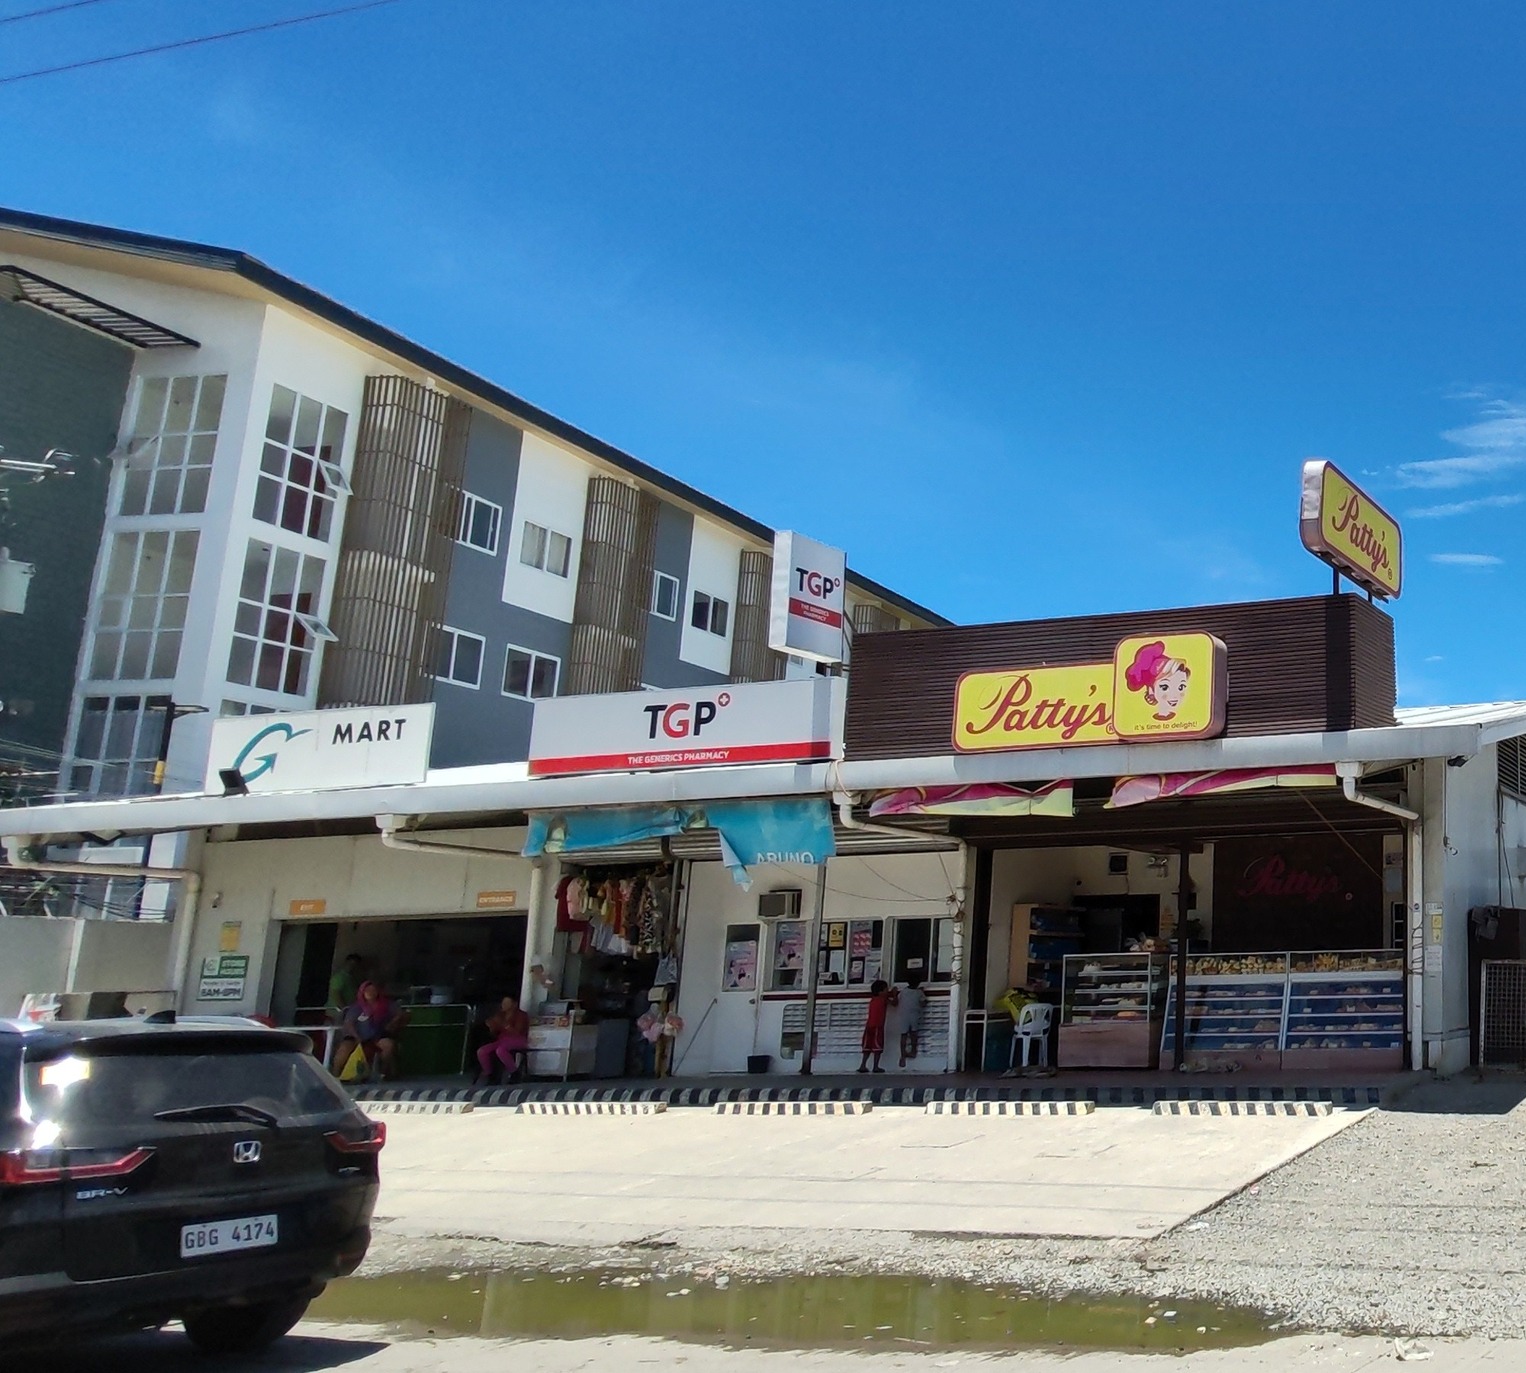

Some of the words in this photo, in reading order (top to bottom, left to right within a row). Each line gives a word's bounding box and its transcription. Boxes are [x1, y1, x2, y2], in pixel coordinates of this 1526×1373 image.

[1331, 486, 1390, 573] Patty's
[795, 567, 834, 600] TGP
[643, 700, 717, 739] TGP
[965, 673, 1112, 740] Patty's
[332, 719, 407, 745] MART
[628, 755, 643, 765] THE
[644, 753, 683, 763] GENERICS
[684, 750, 730, 762] PHARMACY
[76, 1187, 128, 1200] BR-V
[184, 1229, 219, 1250] GBG
[231, 1221, 275, 1243] 4174
